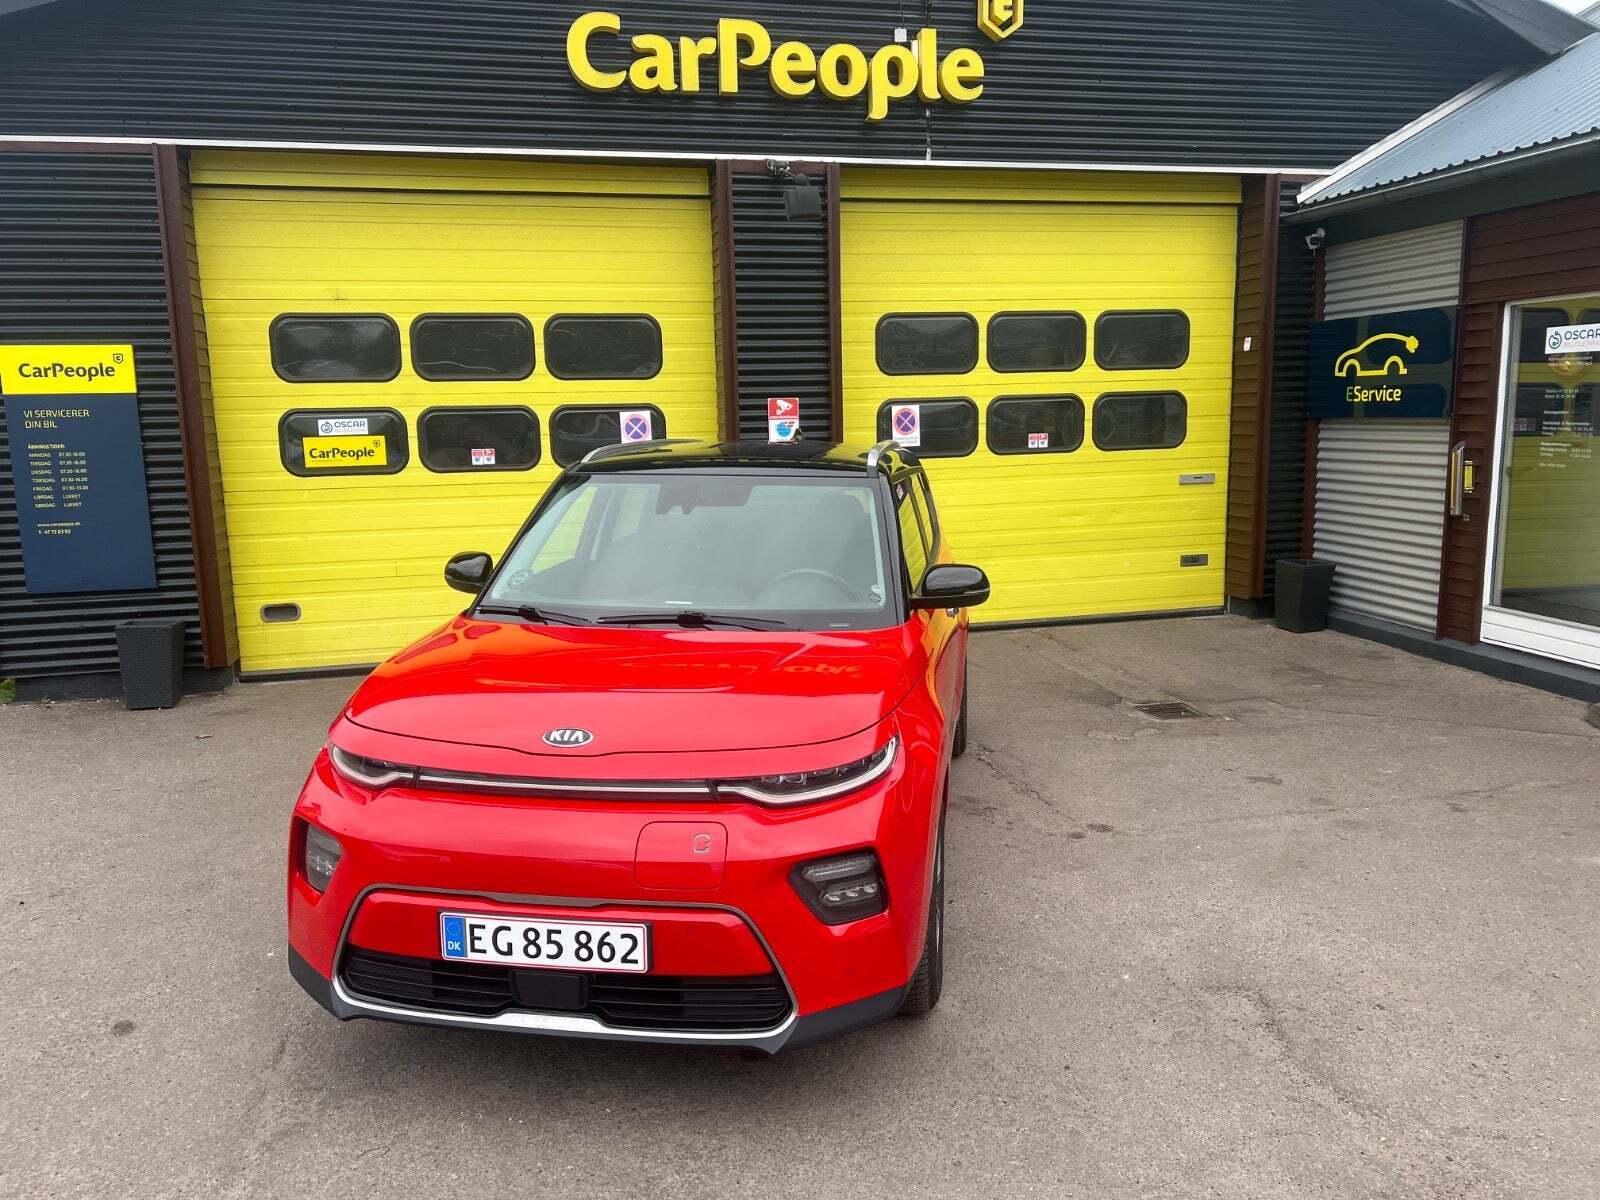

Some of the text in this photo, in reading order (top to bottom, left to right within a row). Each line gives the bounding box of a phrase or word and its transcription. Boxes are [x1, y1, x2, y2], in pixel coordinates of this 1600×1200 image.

[565, 11, 985, 122] CarPeople
[18, 362, 116, 381] CarPeople
[1346, 385, 1402, 402] EService
[23, 409, 90, 419] VI SERVICERER
[25, 420, 58, 429] DIN BIL
[309, 448, 375, 460] CarPeople
[549, 730, 584, 742] KIA
[447, 941, 461, 951] DK
[468, 924, 639, 965] EG 85 862
